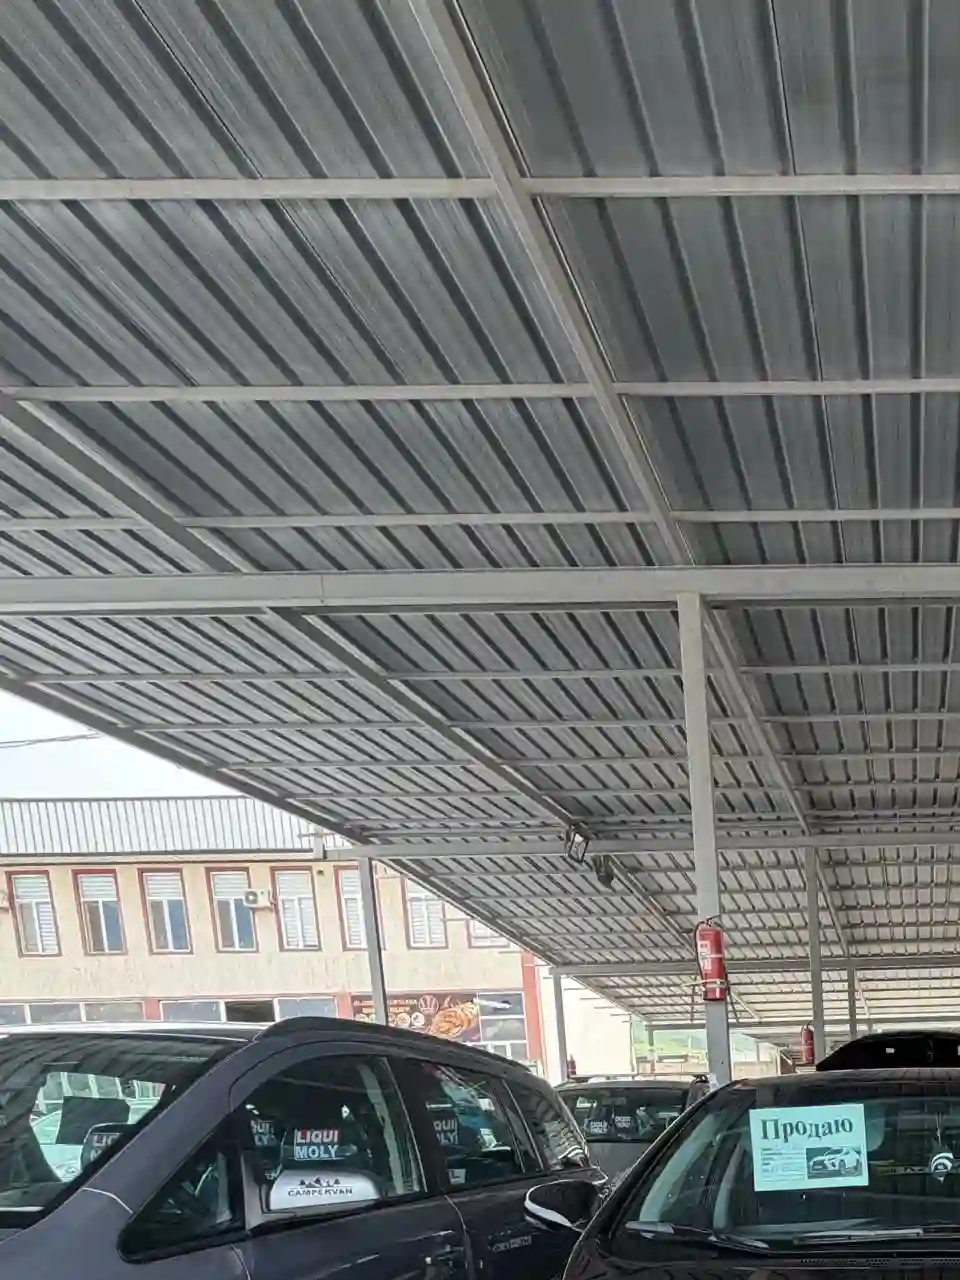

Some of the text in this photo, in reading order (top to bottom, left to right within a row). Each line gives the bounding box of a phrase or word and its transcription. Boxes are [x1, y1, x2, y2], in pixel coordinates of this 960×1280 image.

[296, 1130, 339, 1144] LIQUI
[760, 1117, 854, 1143] Продаю
[294, 1144, 339, 1159] MOLY
[287, 1187, 353, 1197] CAMPERVAN
